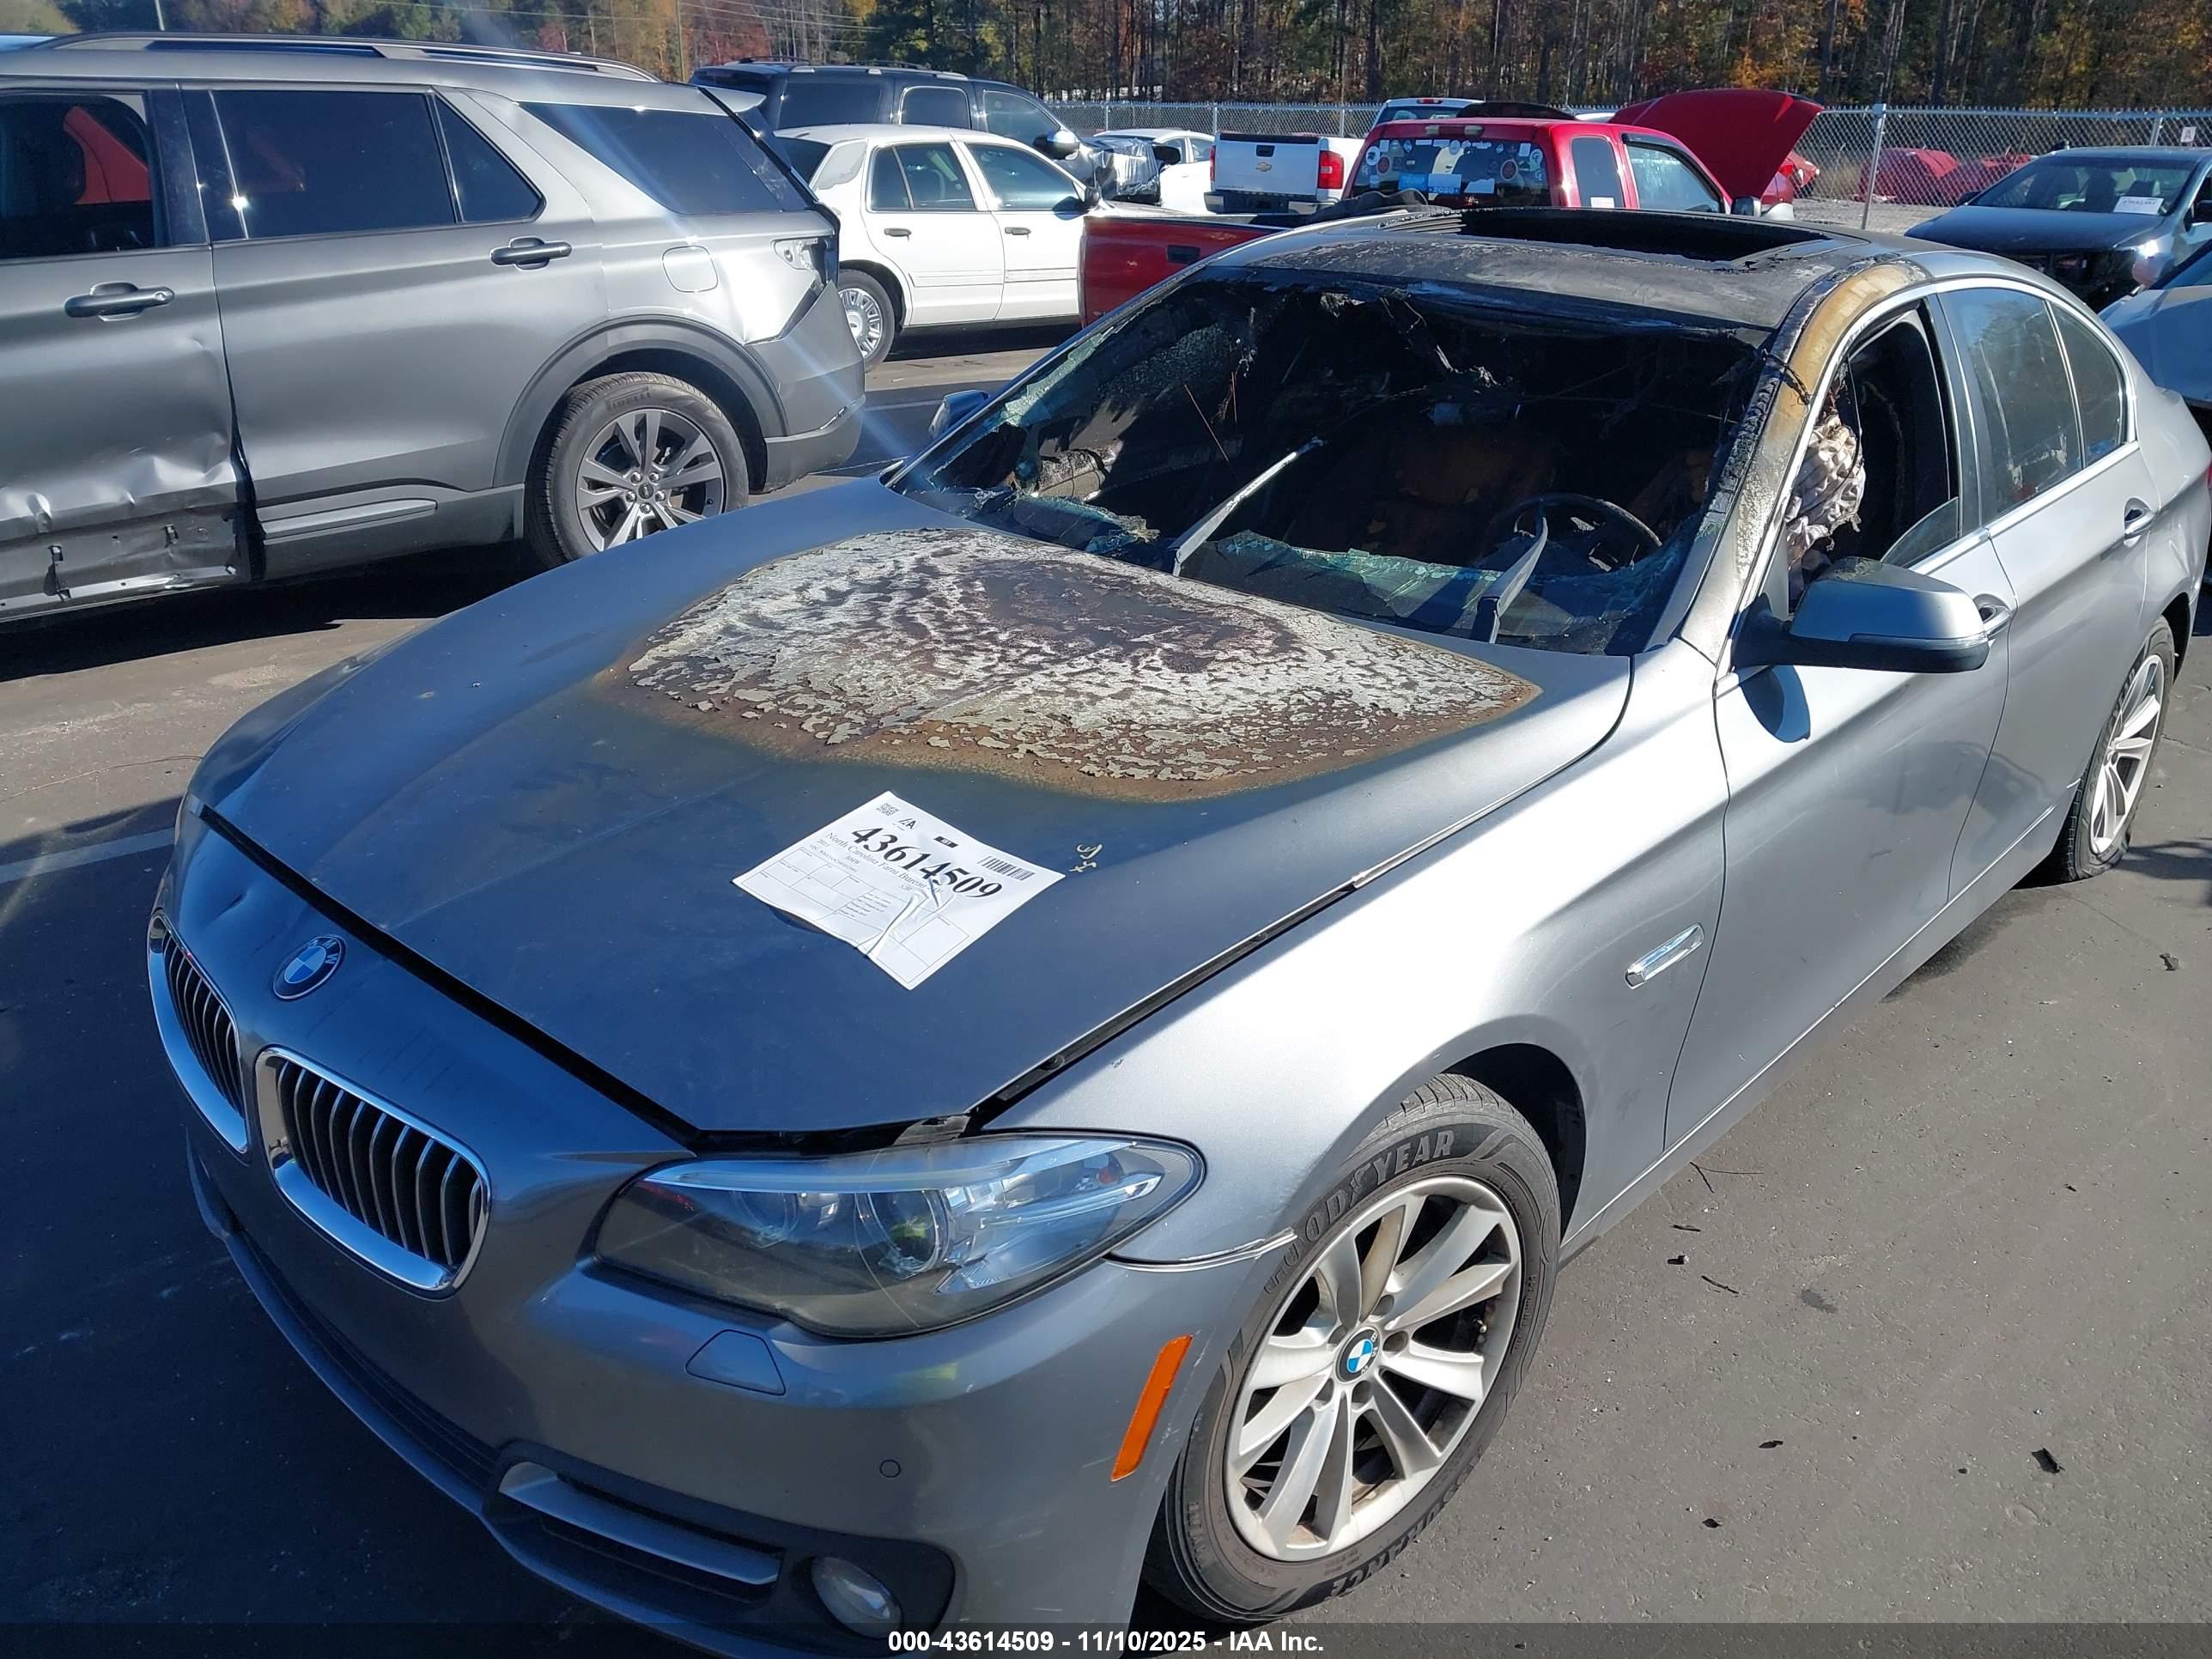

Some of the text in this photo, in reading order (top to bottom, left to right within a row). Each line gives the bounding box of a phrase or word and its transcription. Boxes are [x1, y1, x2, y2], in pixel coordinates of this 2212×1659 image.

[825, 832, 848, 848] North
[848, 845, 878, 865] Carolina
[878, 861, 900, 875] Farm
[852, 827, 1003, 898] 43614509
